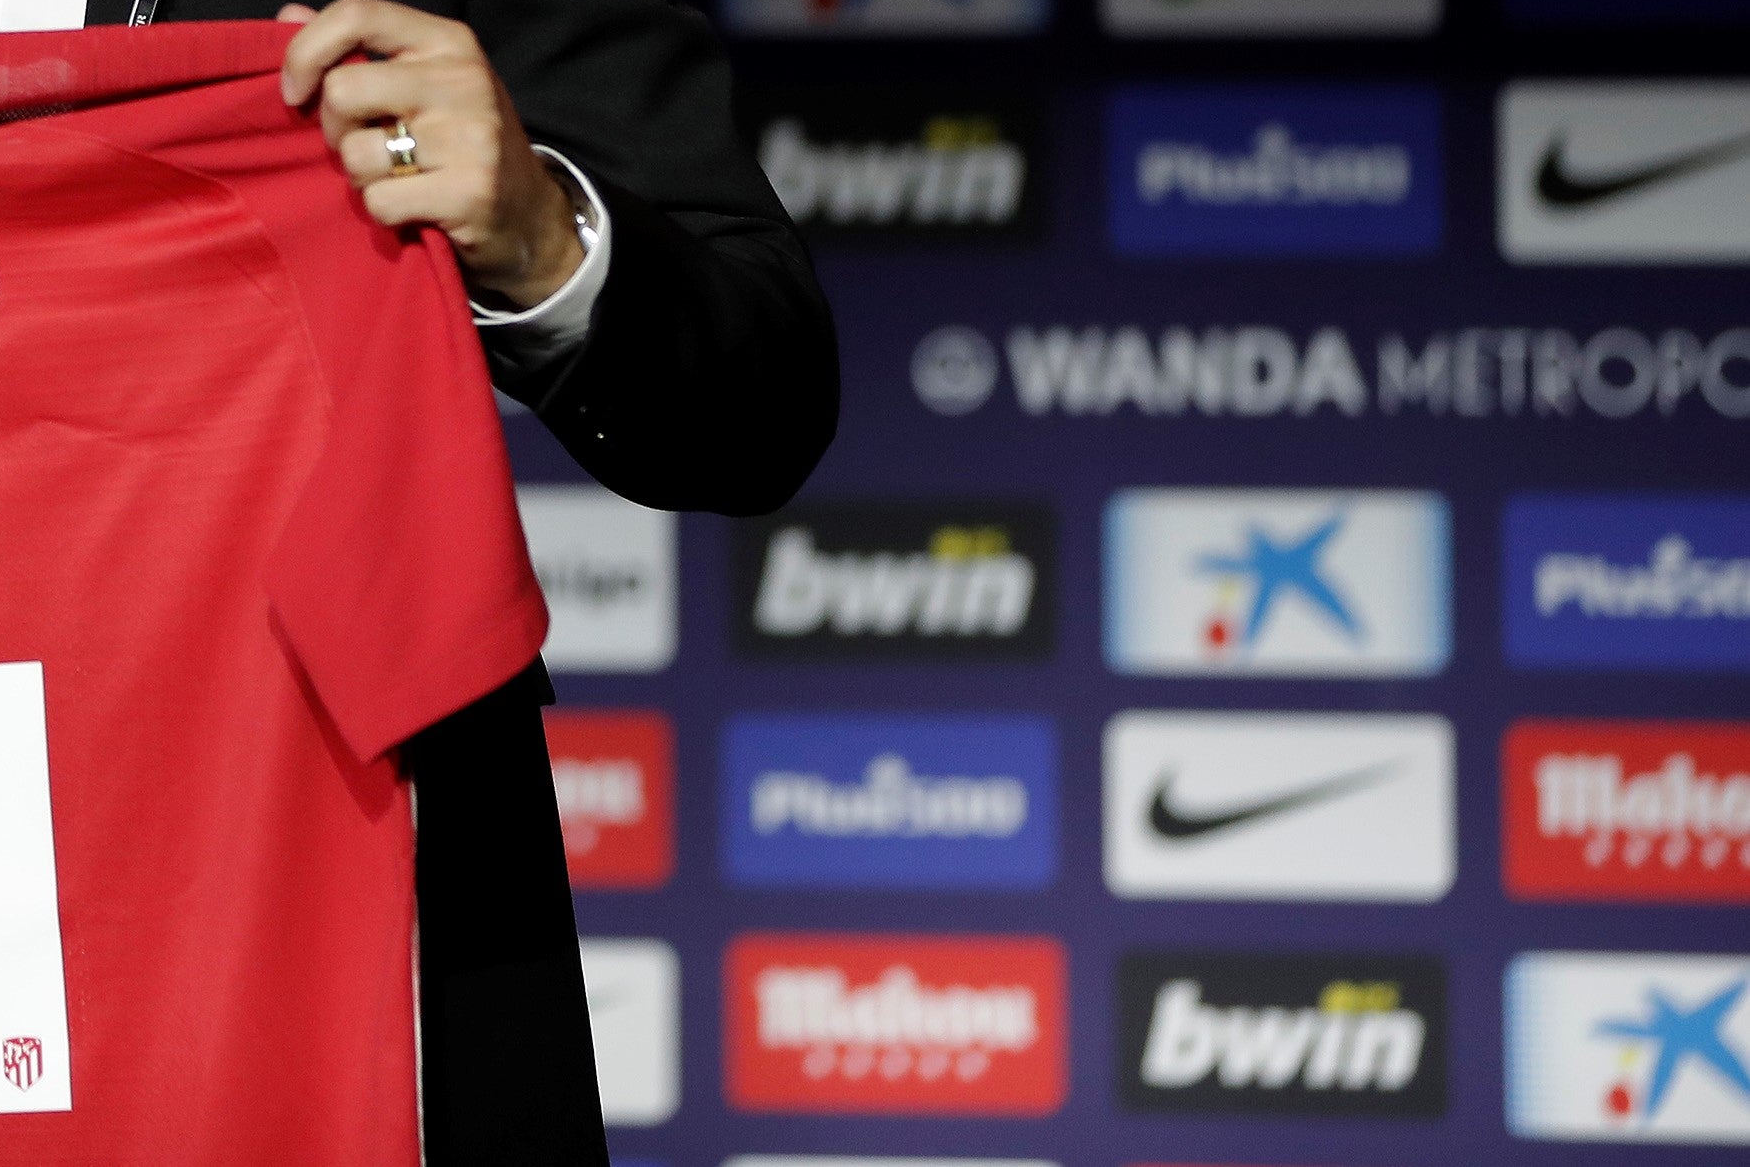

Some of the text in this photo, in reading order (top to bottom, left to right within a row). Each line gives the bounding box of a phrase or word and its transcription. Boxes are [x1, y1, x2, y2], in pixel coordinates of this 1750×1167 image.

[1006, 328, 1366, 416] WANDA
[754, 527, 1036, 636] bwin
[1140, 978, 1426, 1091] bwin
